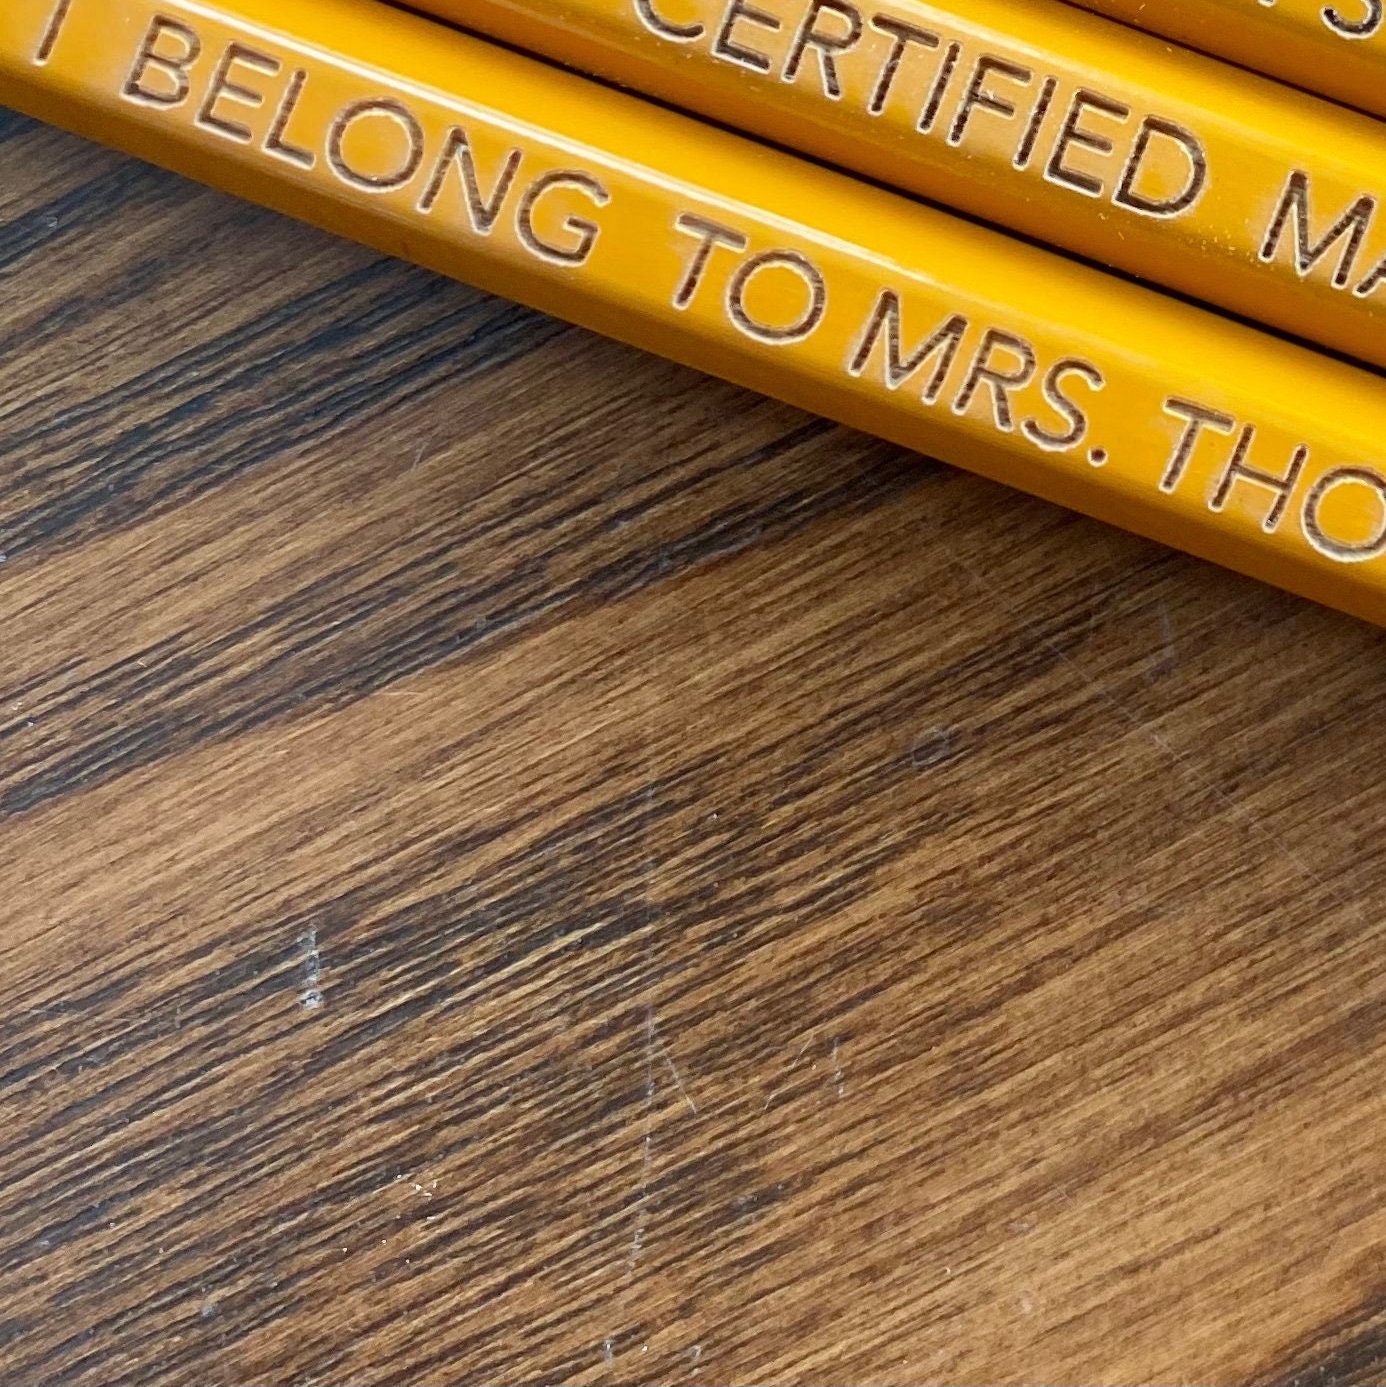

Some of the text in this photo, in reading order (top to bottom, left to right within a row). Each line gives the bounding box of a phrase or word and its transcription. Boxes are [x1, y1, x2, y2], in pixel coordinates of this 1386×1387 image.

[120, 14, 612, 269] BELONG
[671, 213, 826, 345] TO
[847, 288, 1109, 468] MRS.
